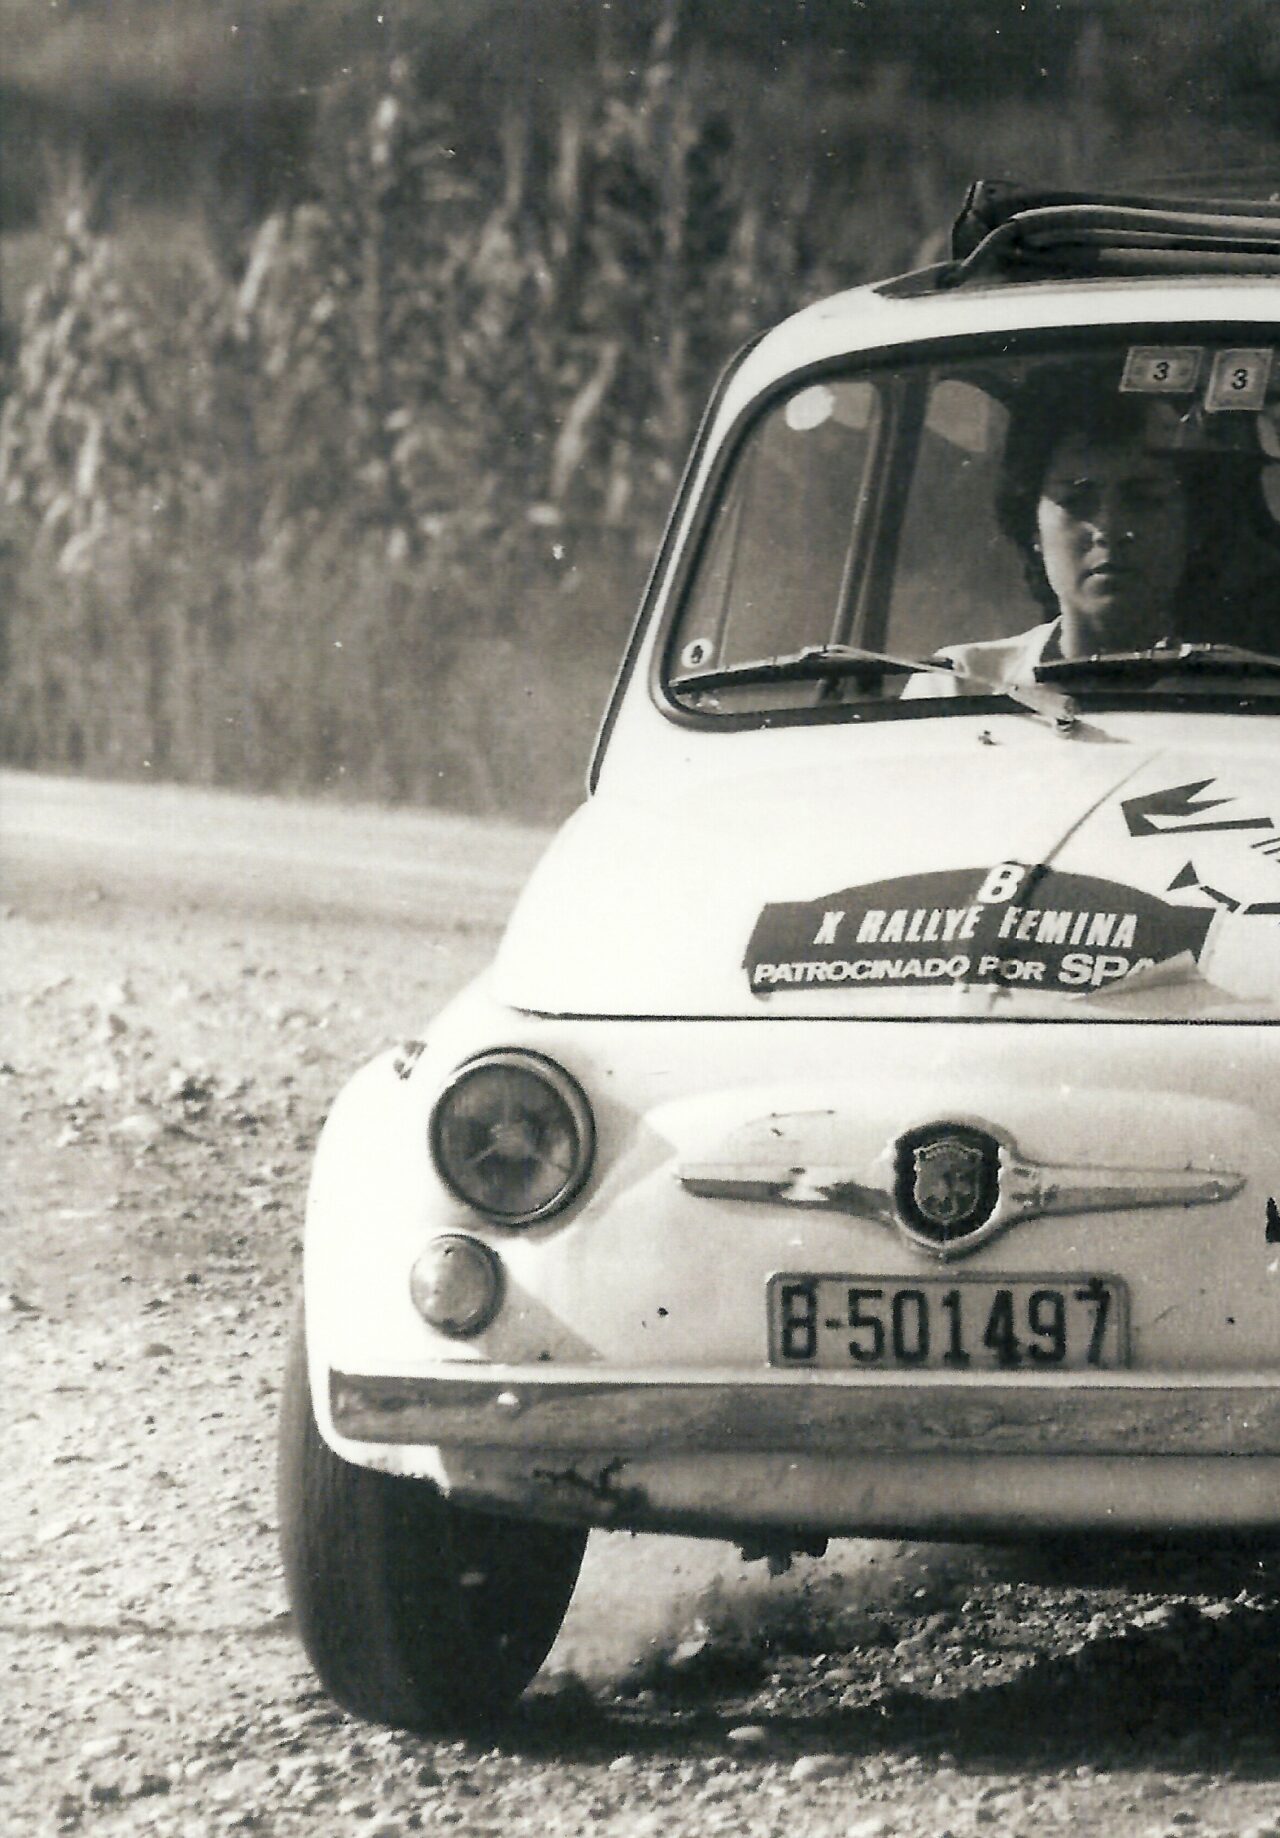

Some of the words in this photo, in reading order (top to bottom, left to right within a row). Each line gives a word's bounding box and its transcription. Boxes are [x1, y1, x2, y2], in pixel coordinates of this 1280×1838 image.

[1153, 361, 1169, 381] 3
[1231, 368, 1248, 390] 3
[812, 911, 846, 945] X
[856, 905, 985, 944] RALLYE
[999, 906, 1138, 948] FEMINA
[753, 954, 969, 984] PATROCINADO
[977, 956, 1044, 982] POR
[781, 1281, 1112, 1367] B-501497
